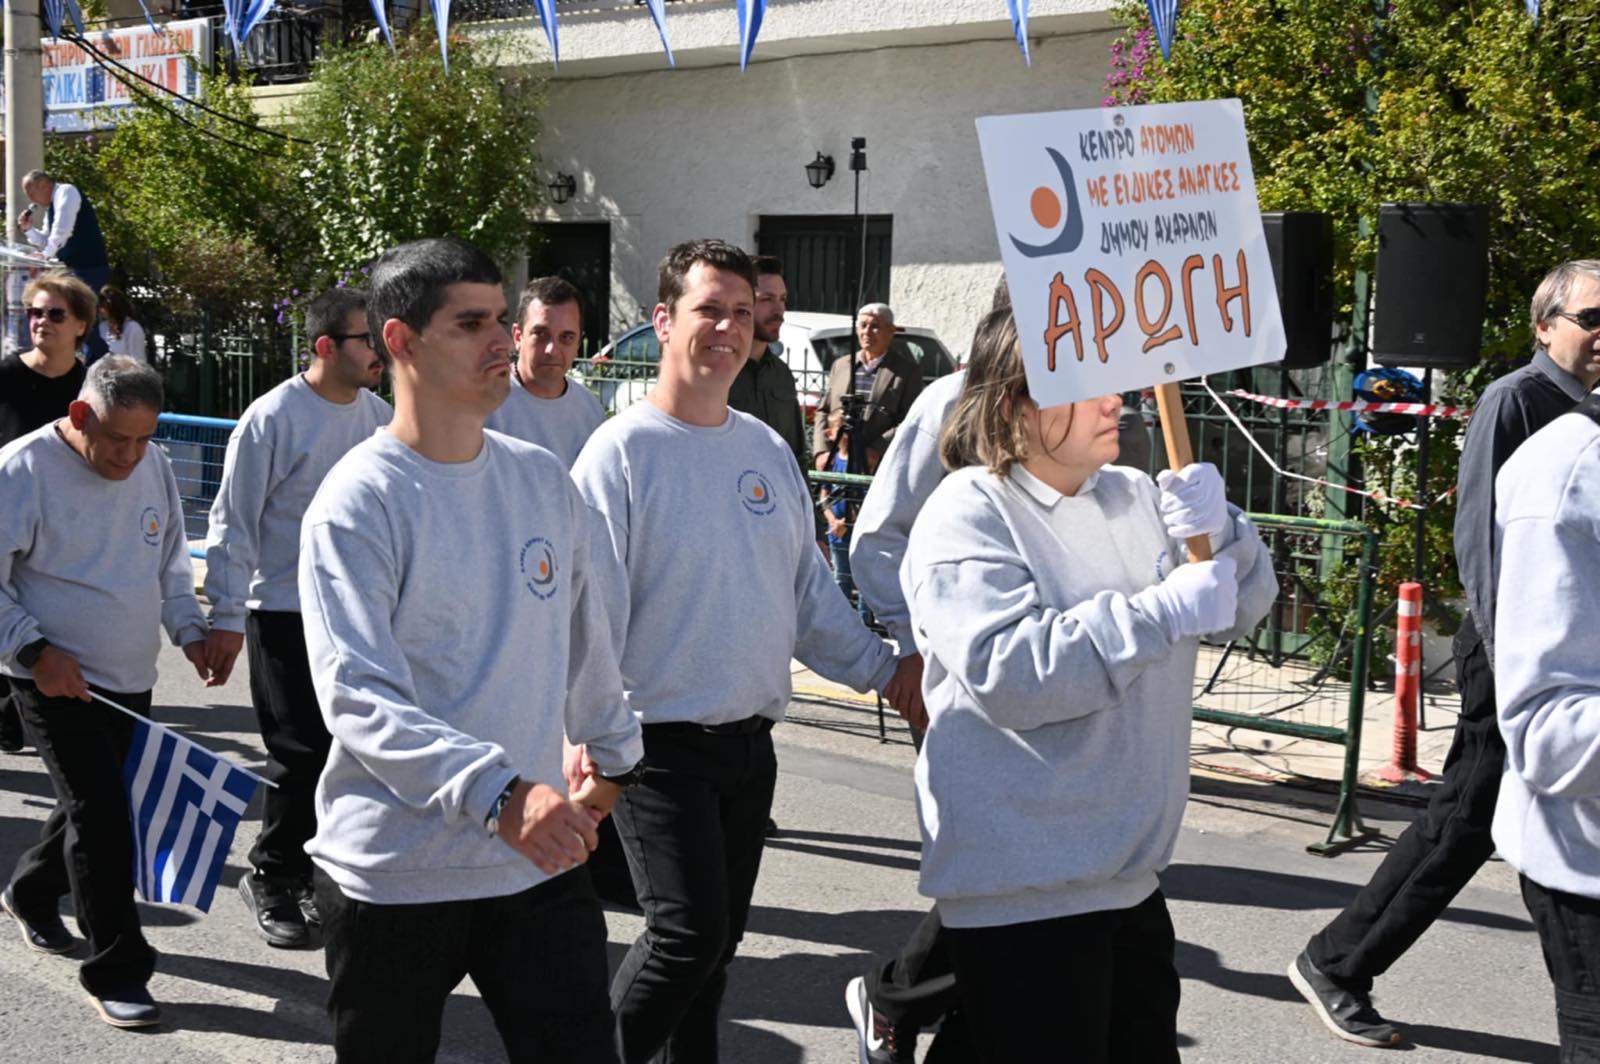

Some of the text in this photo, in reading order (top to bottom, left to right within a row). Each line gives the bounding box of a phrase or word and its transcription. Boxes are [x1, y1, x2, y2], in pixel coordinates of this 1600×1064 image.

[1080, 123, 1195, 162] ΚΕΝΤΡΟ ΑΤΟΜΩΝ
[1086, 161, 1241, 208] ΜΕ ΕΙΔΙΚΕΣ ΑΝΑΓΚΕΣ
[1100, 209, 1218, 257] ΔΗΜΟΥ ΑΧΑΡΝΩΝ
[1044, 248, 1251, 372] ΑΡΩΓΗ
